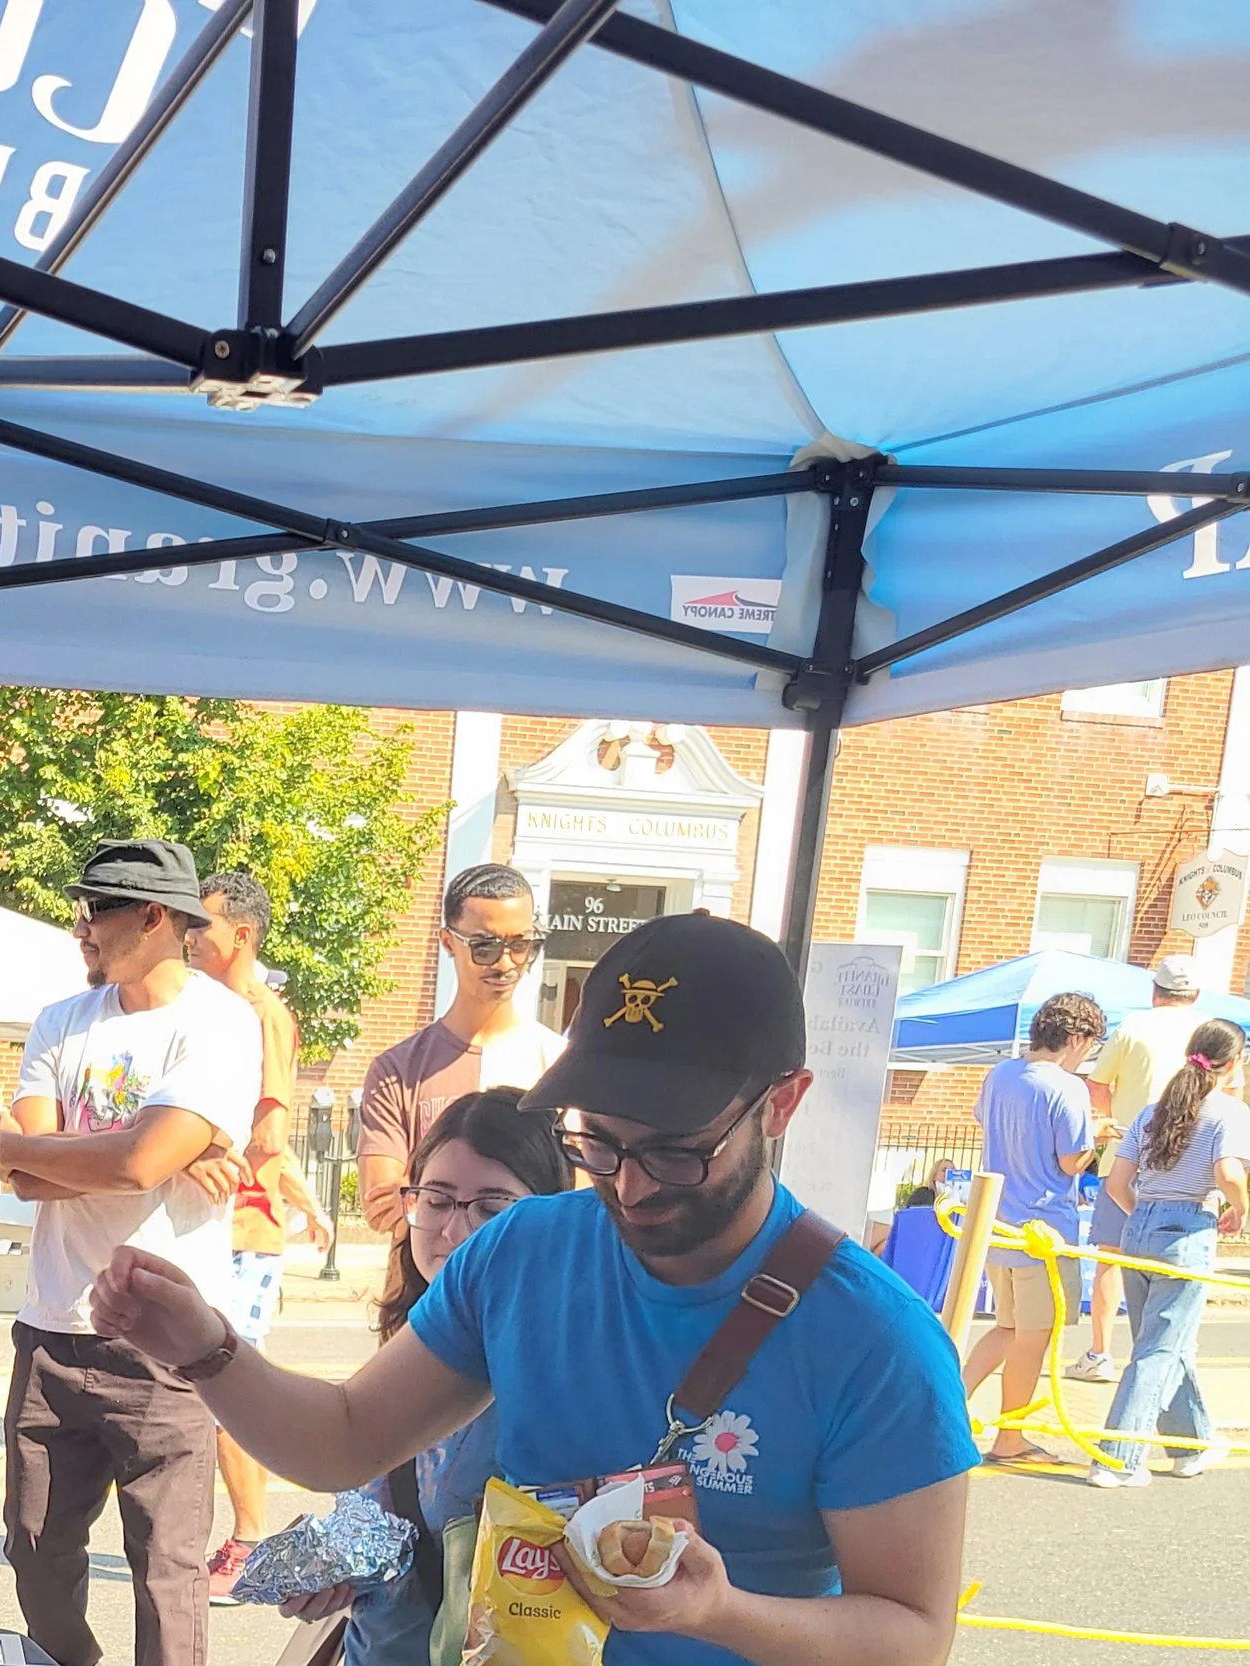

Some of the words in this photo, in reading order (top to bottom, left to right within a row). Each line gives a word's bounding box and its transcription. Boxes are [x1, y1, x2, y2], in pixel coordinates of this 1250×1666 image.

[528, 812, 607, 833] KNIGHTS
[629, 818, 729, 841] COLUMBUS
[584, 896, 604, 914] 96
[696, 1475, 753, 1495] SUMMER
[508, 1602, 561, 1620] Classic
